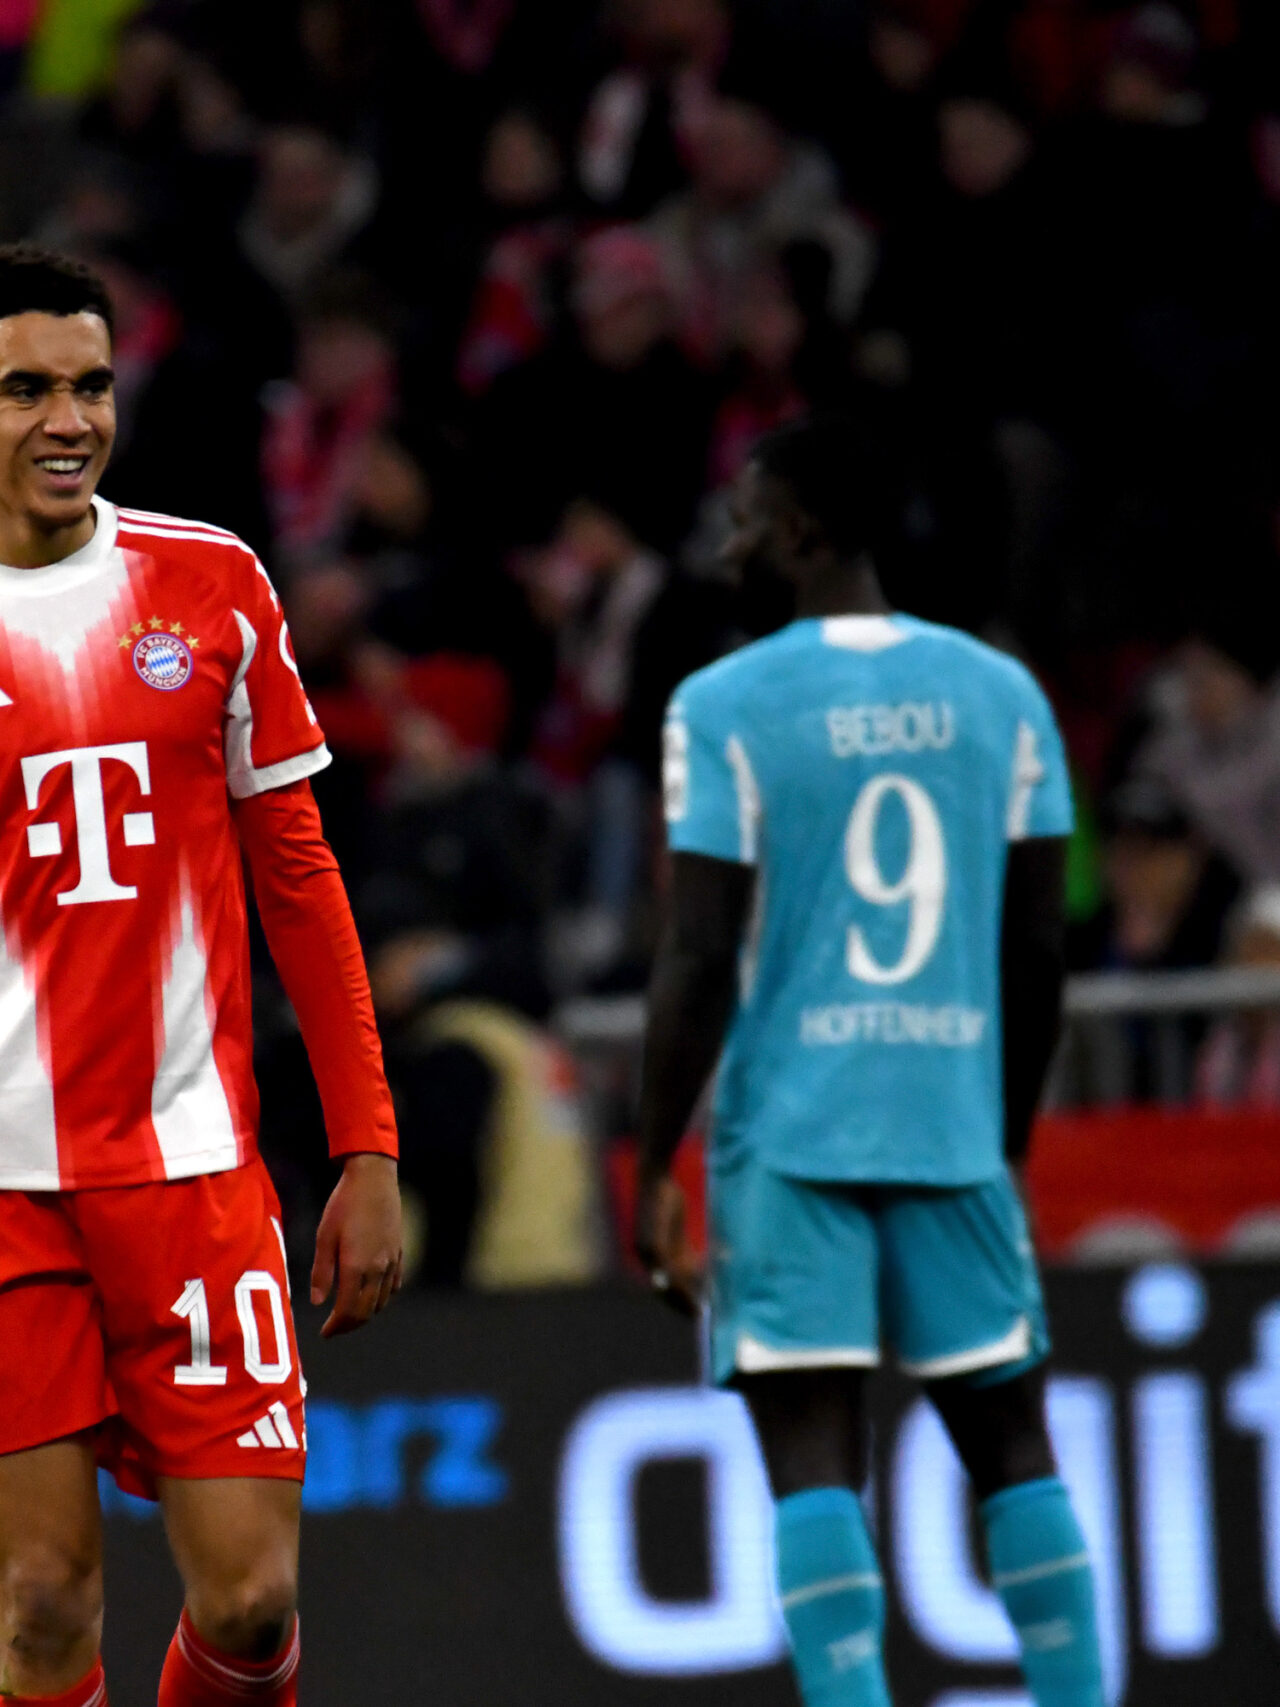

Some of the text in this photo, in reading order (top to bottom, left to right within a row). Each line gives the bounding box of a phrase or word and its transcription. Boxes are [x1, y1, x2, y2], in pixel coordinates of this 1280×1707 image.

[826, 701, 956, 757] BEBOU
[21, 741, 156, 906] T
[845, 772, 947, 986] 9
[170, 1269, 292, 1386] 10
